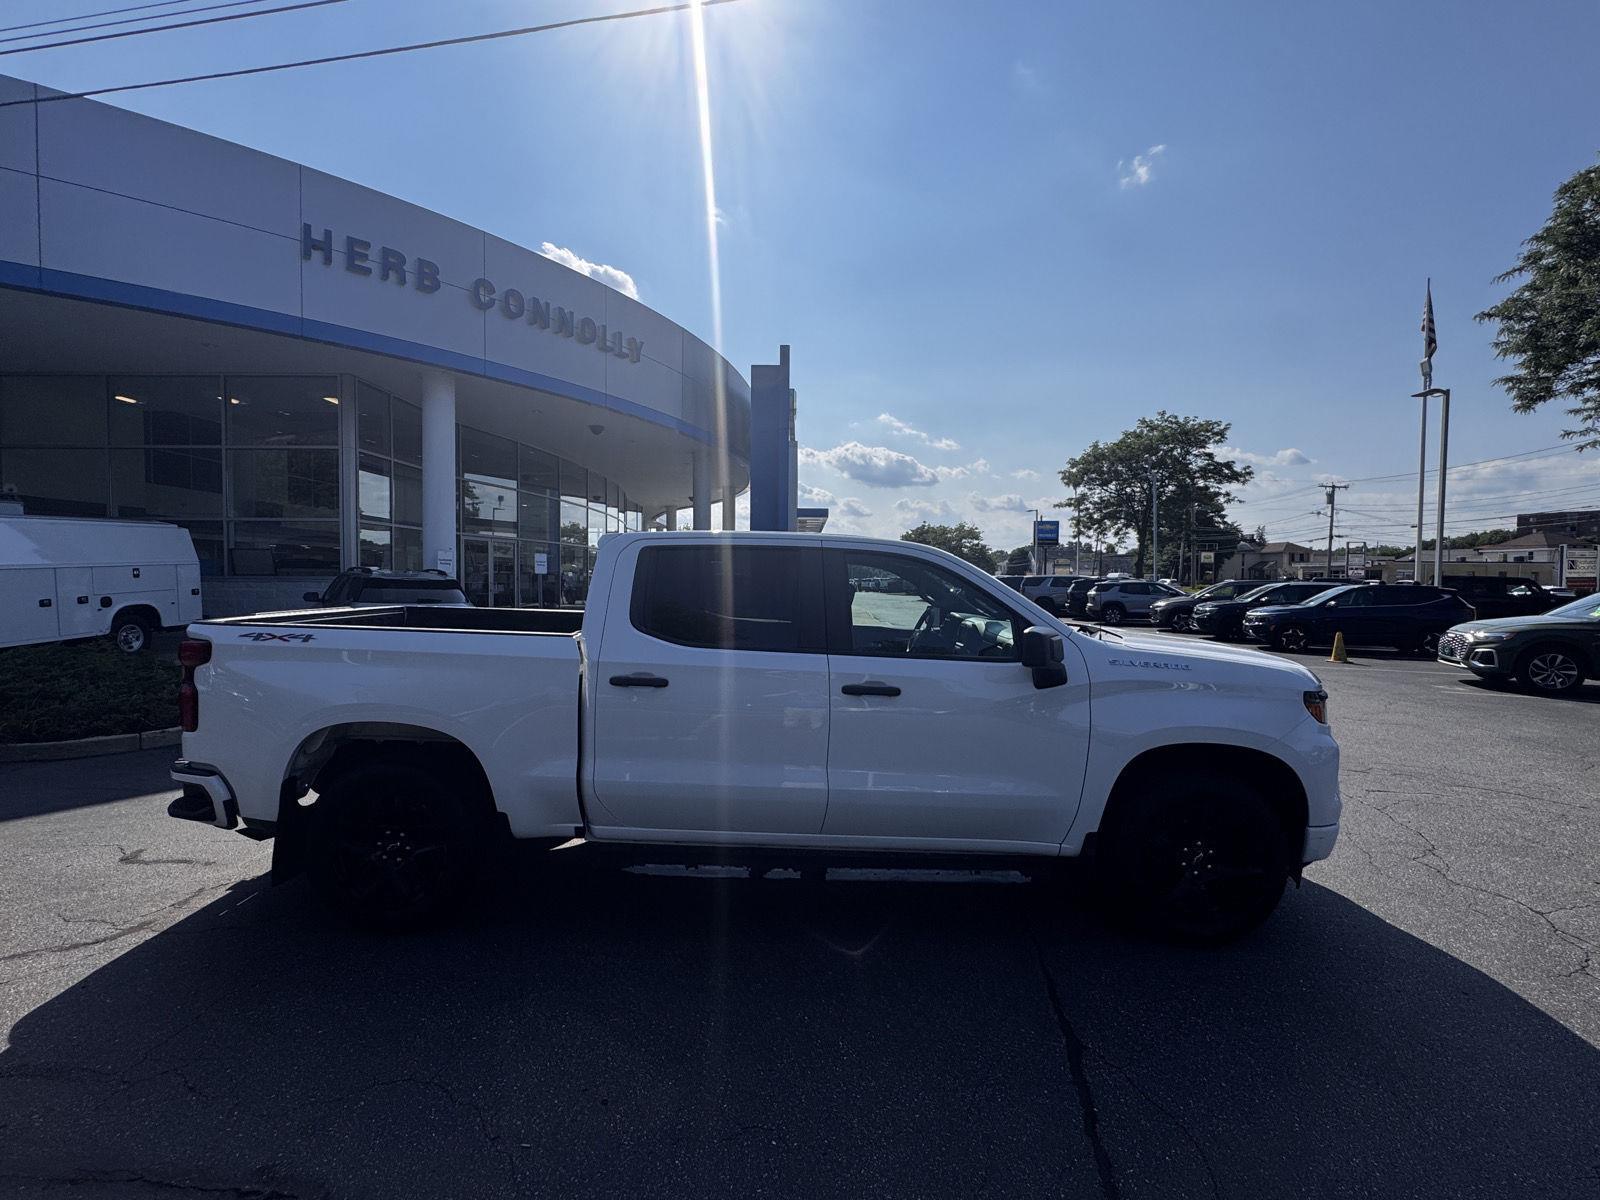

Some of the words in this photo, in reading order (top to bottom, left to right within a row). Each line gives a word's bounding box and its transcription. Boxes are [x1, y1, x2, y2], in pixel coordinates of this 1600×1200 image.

[302, 222, 442, 295] HERB
[470, 277, 645, 364] CONNOLLY
[1107, 658, 1193, 671] SILVERADO
